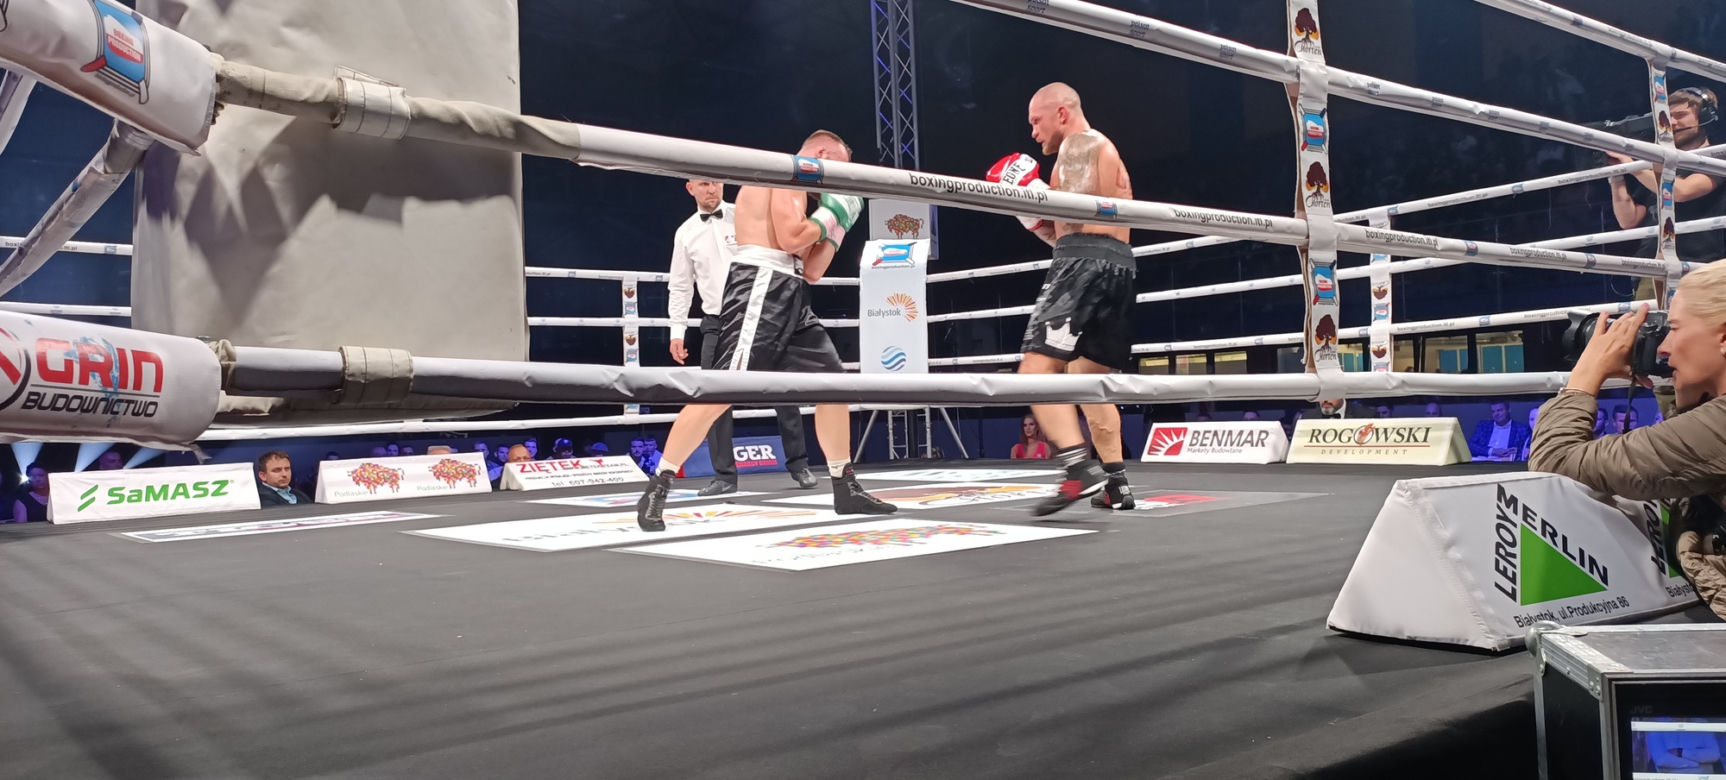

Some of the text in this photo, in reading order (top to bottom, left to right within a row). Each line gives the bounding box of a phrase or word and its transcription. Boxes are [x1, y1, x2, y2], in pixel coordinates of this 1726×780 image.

[22, 391, 158, 418] BUDOWNICTWO
[1188, 429, 1270, 448] BENMAR
[1308, 424, 1432, 444] ROGOWSKI
[732, 444, 777, 462] GER
[1320, 448, 1408, 456] DEVELOPMENT
[516, 459, 584, 474] ZIĘTEK
[107, 479, 230, 505] SaMASZ
[1496, 483, 1610, 587] MERLIN
[1494, 501, 1518, 603] LEROY
